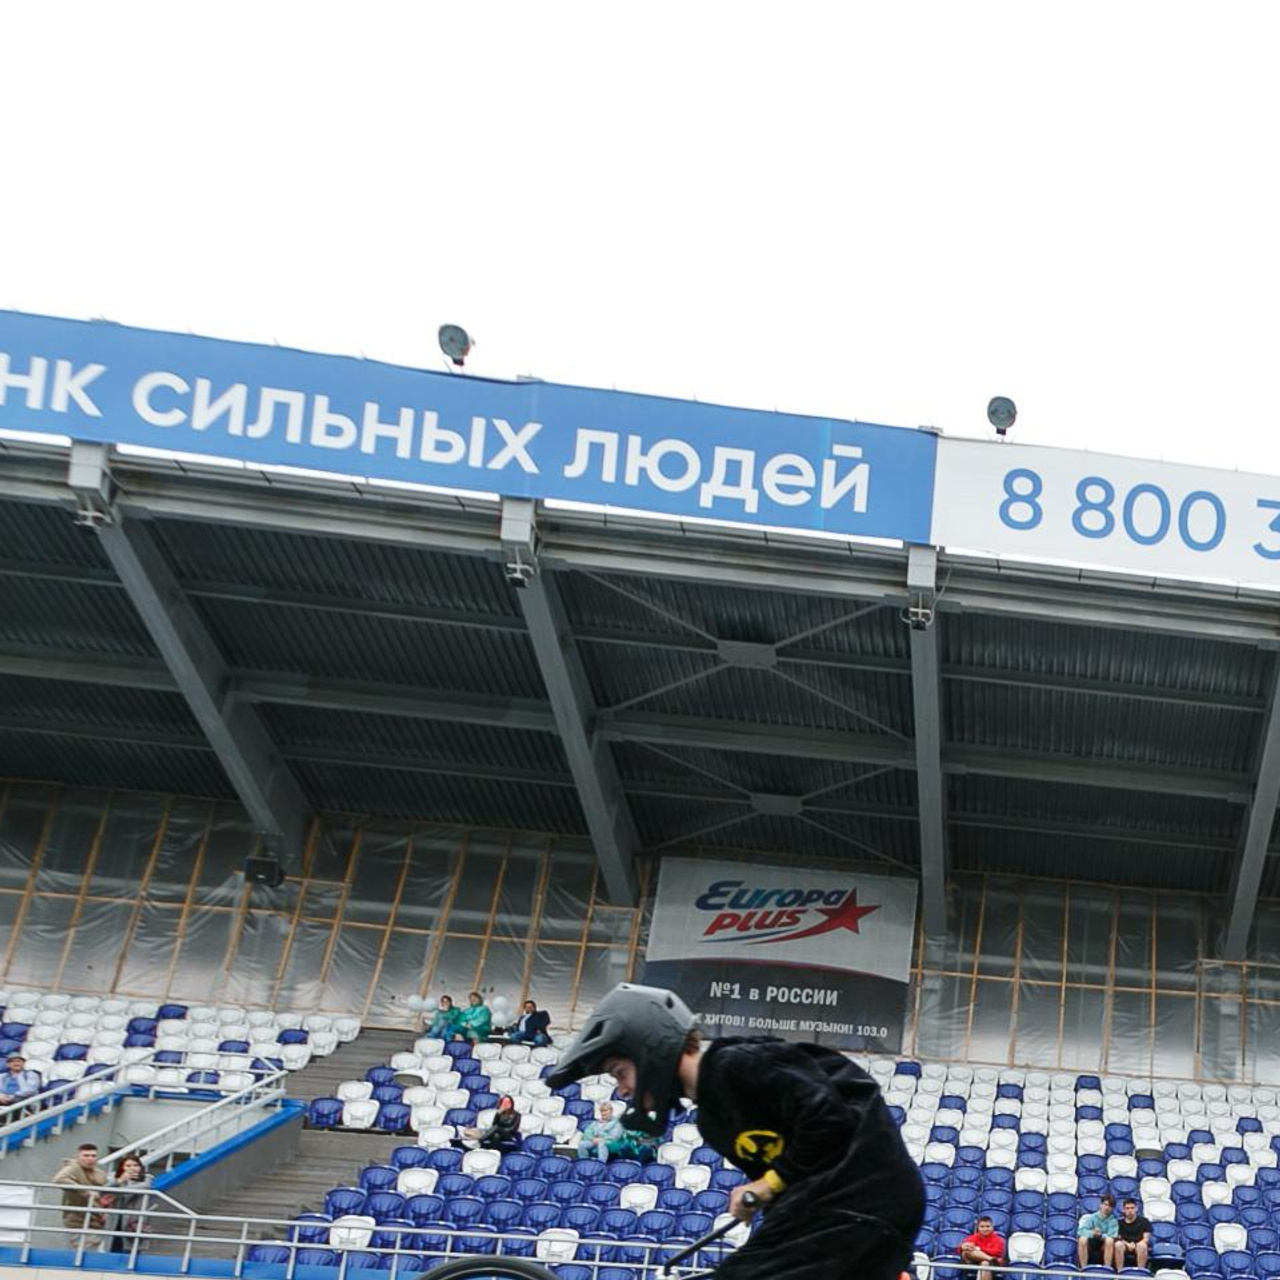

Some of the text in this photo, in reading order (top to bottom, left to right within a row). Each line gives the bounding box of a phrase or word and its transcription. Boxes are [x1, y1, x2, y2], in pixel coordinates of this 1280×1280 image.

[563, 428, 870, 513] людей
[996, 467, 1044, 531] 8
[1070, 475, 1227, 553] 800
[710, 981, 741, 999] №1
[766, 986, 838, 1006] РОССИИ
[748, 1017, 798, 1031] БОЛЬШЕ
[799, 1021, 854, 1036] МУЗЫКИ!
[857, 1025, 888, 1038] 103.0
